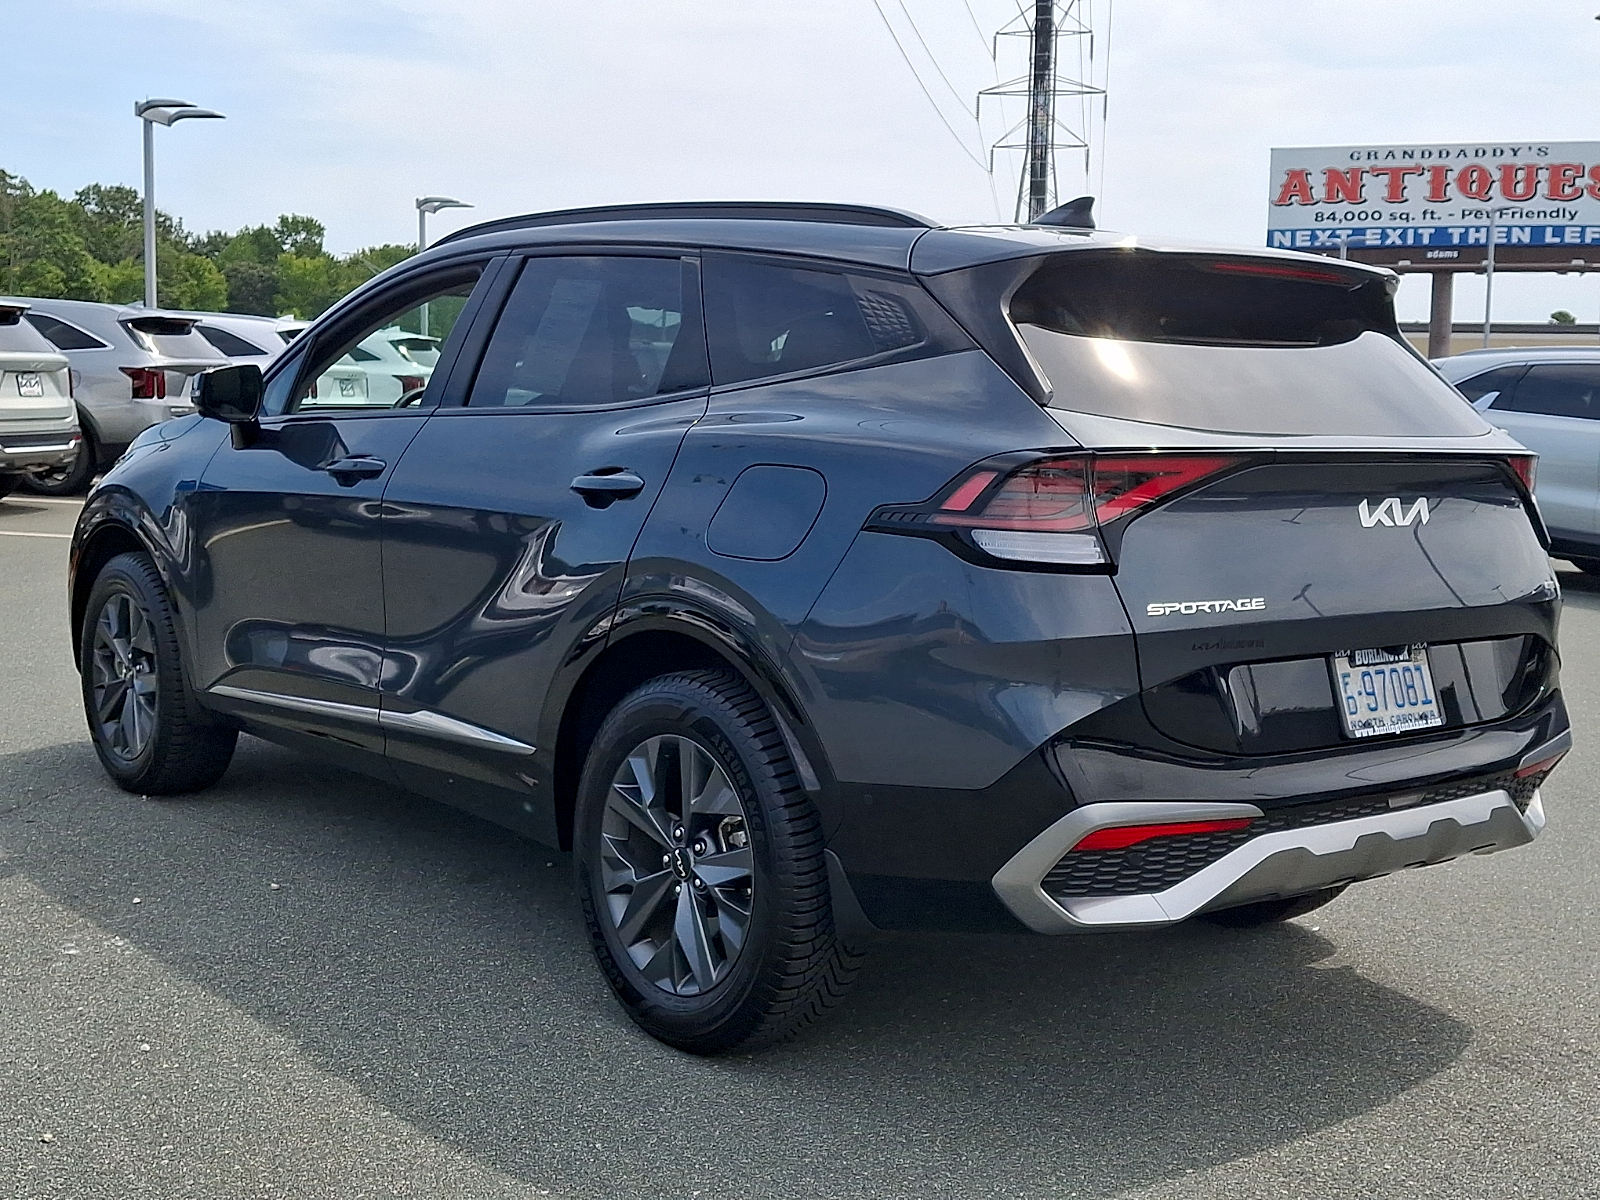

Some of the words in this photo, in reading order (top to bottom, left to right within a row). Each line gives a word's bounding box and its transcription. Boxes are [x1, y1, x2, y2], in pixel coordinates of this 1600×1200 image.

[1350, 146, 1549, 161] GRANDDADDY'S
[1314, 210, 1382, 224] 84,000
[1389, 212, 1415, 224] sq.
[1422, 208, 1442, 220] ft.
[1499, 207, 1579, 221] Friendly
[1272, 229, 1353, 247] NEXT
[1365, 228, 1436, 246] EXIT
[1447, 227, 1532, 244] THEN
[1358, 497, 1430, 527] KIA
[1146, 597, 1266, 616] SPORTAGE
